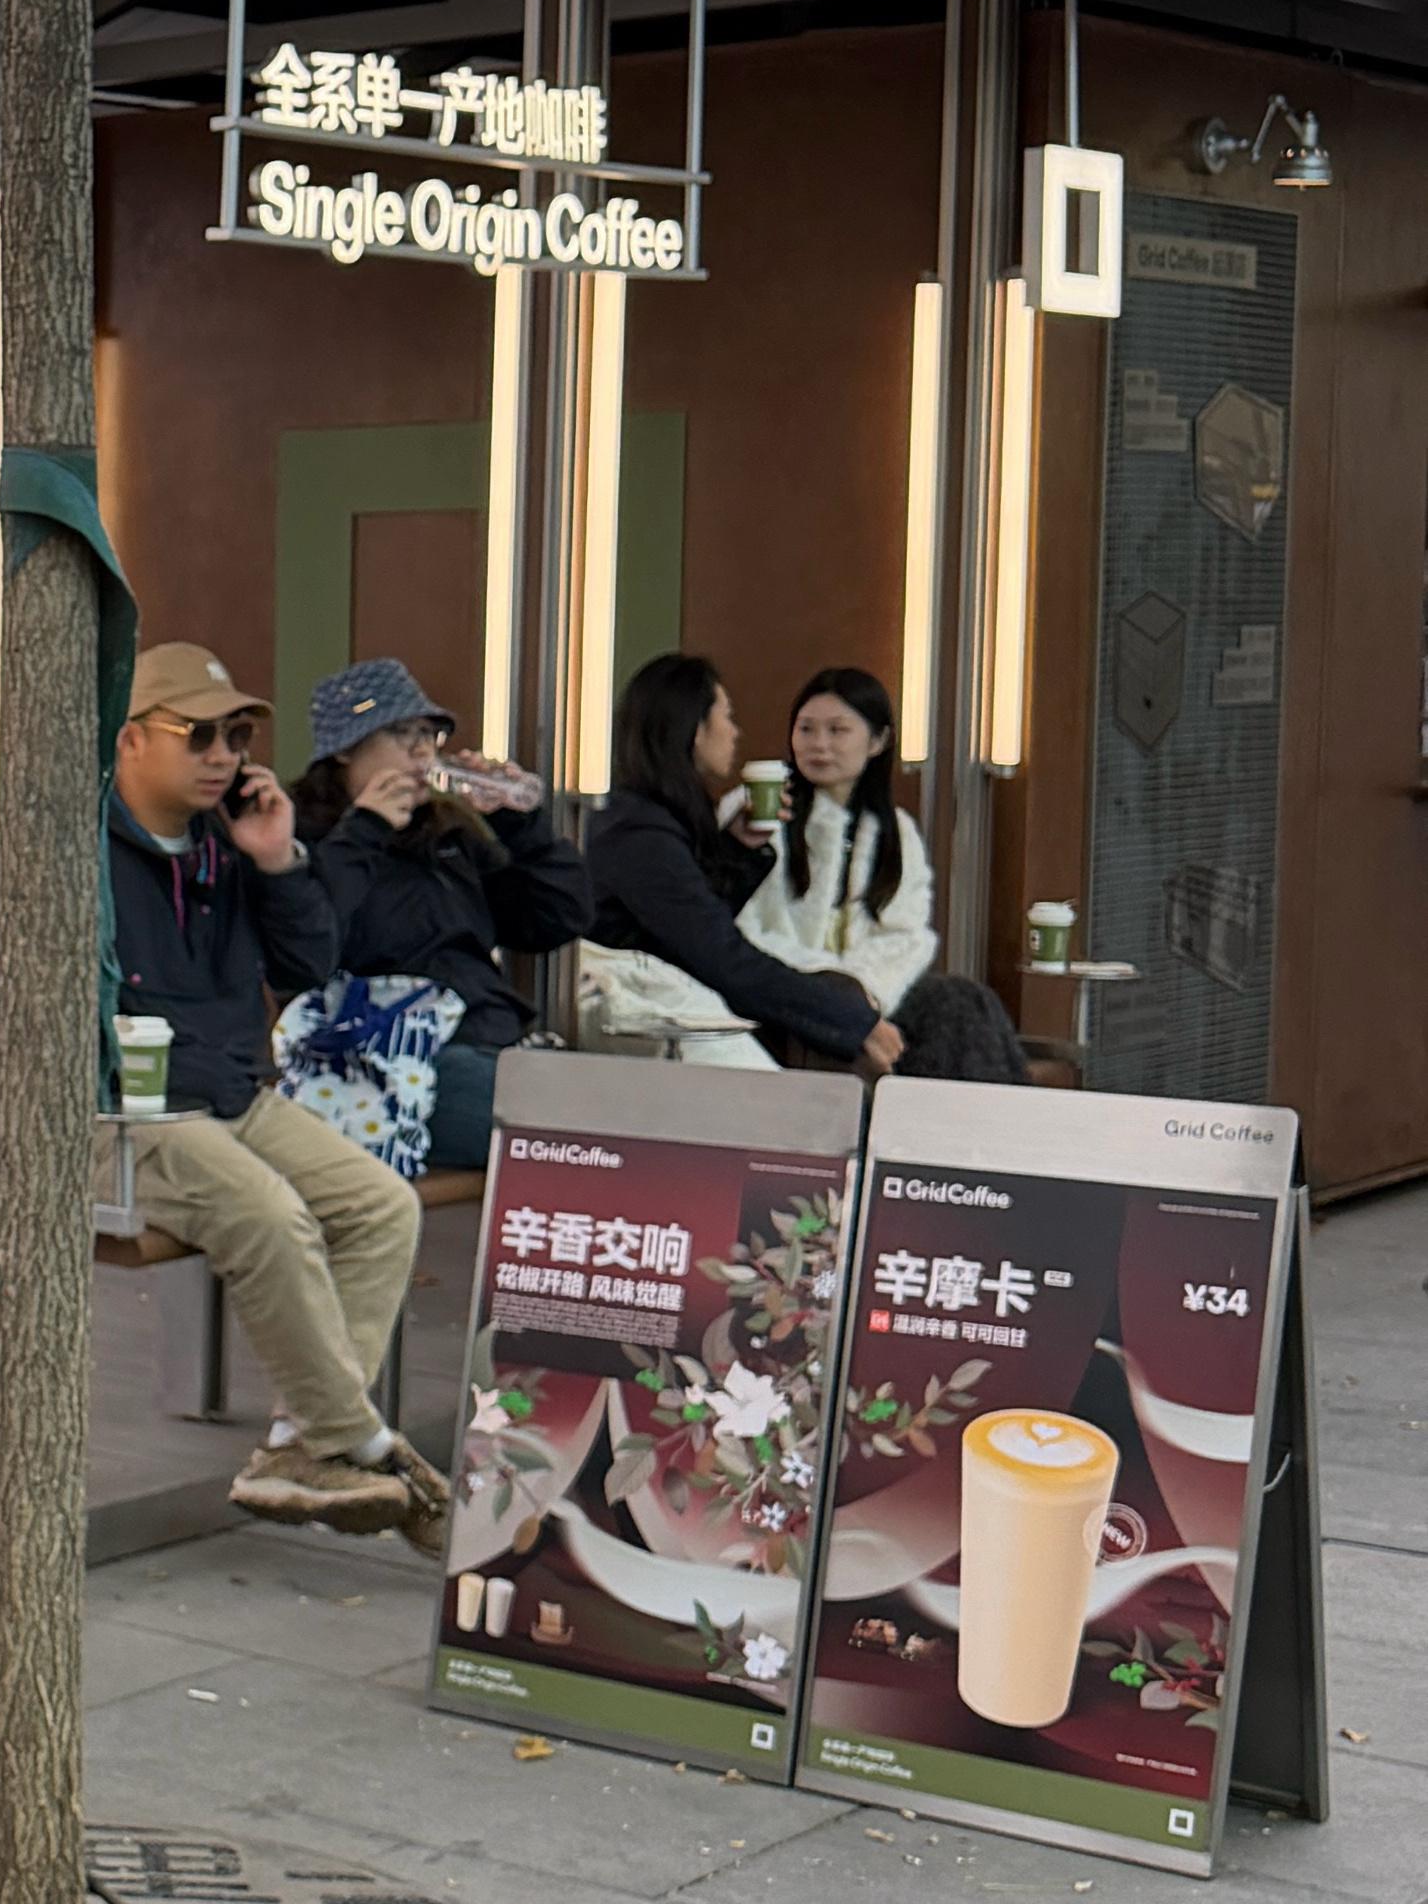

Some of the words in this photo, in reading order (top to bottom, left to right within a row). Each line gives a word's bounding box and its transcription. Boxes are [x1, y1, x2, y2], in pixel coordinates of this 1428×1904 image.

[259, 42, 609, 165] 全系单一产地咖啡
[257, 159, 406, 264] Single
[409, 178, 543, 277] Origin
[545, 192, 684, 271] Coffee
[1209, 1122, 1275, 1144] Coffee
[500, 1206, 692, 1277] 辛香交响
[874, 1249, 1039, 1318] 辛摩卡
[1181, 1282, 1251, 1318] ¥34
